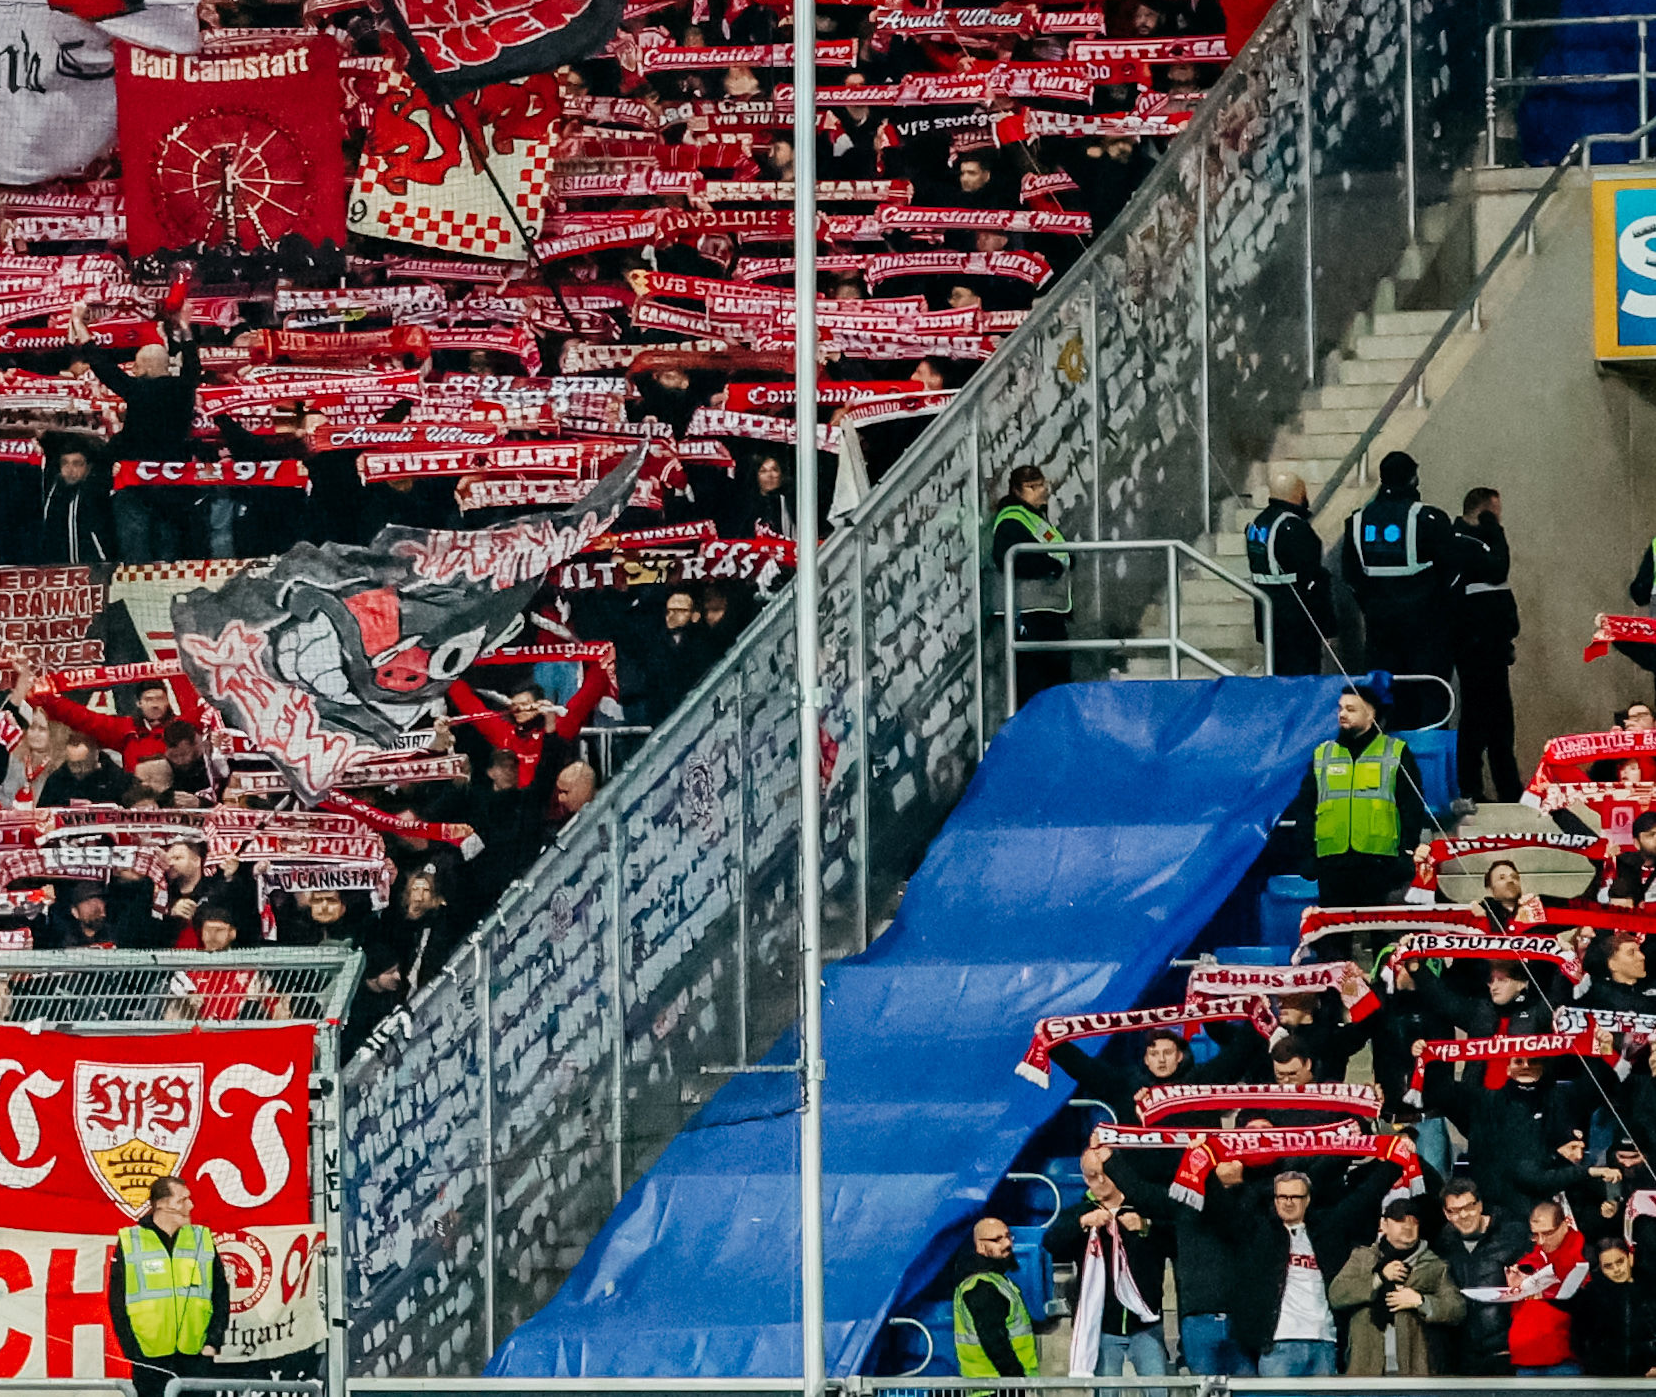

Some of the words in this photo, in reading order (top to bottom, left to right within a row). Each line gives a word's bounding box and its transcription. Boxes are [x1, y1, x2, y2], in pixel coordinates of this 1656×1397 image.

[879, 10, 949, 28] Avanti
[957, 9, 1022, 27] Ultras
[130, 47, 177, 80] Bad
[182, 47, 309, 83] Cannstatt
[330, 427, 415, 446] Avanti
[424, 426, 497, 445] Ultras
[136, 461, 185, 480] CC
[234, 461, 282, 480] 97
[1405, 935, 1441, 951] VfB
[1445, 935, 1560, 953] STUTTGART
[1047, 998, 1247, 1038] STUTTGART
[1429, 1044, 1460, 1056] VfB
[1466, 1036, 1576, 1055] STUTTGART
[89, 1076, 194, 1151] VfB
[1097, 1128, 1163, 1145] Bad
